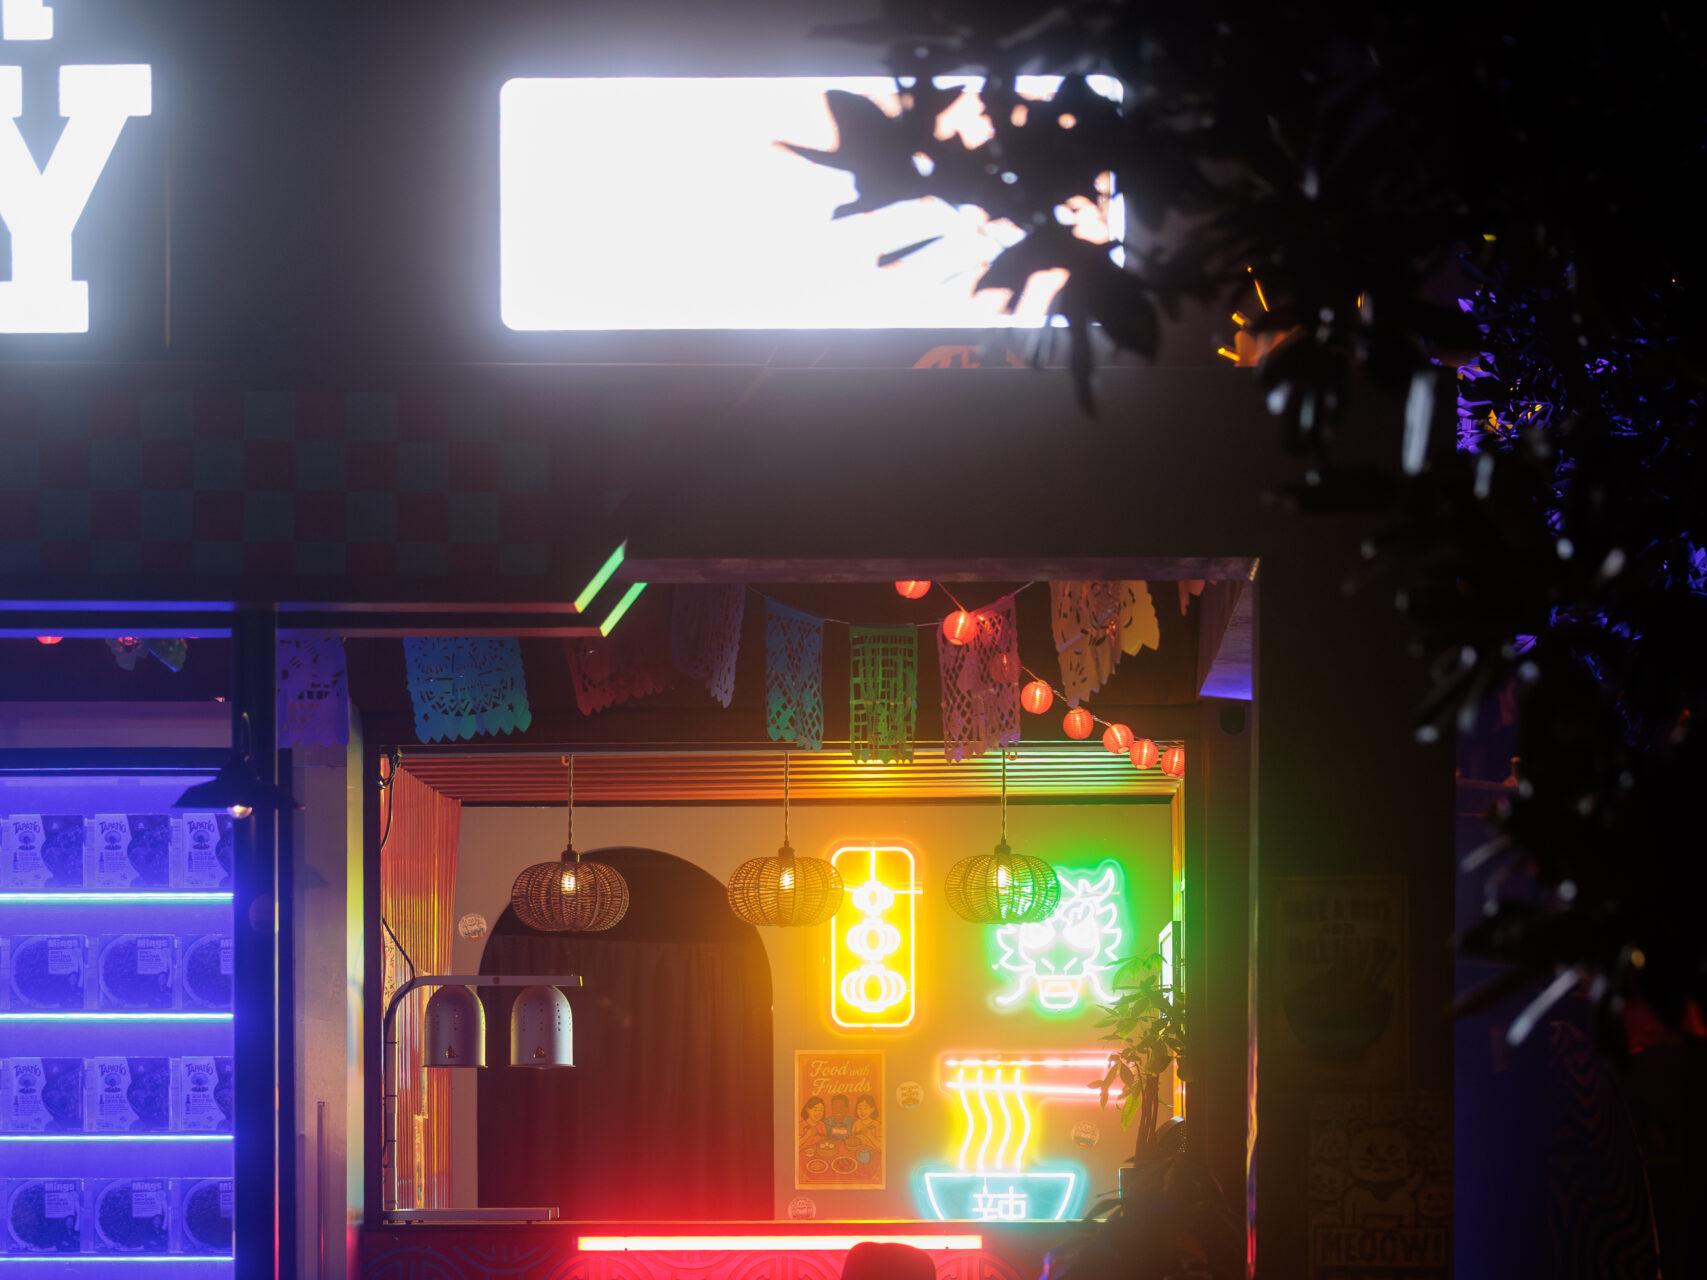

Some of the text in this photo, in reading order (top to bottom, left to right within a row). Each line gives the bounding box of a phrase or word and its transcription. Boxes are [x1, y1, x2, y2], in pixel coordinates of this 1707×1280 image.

[809, 1060, 871, 1077] Food with
[811, 1078, 872, 1096] Friends
